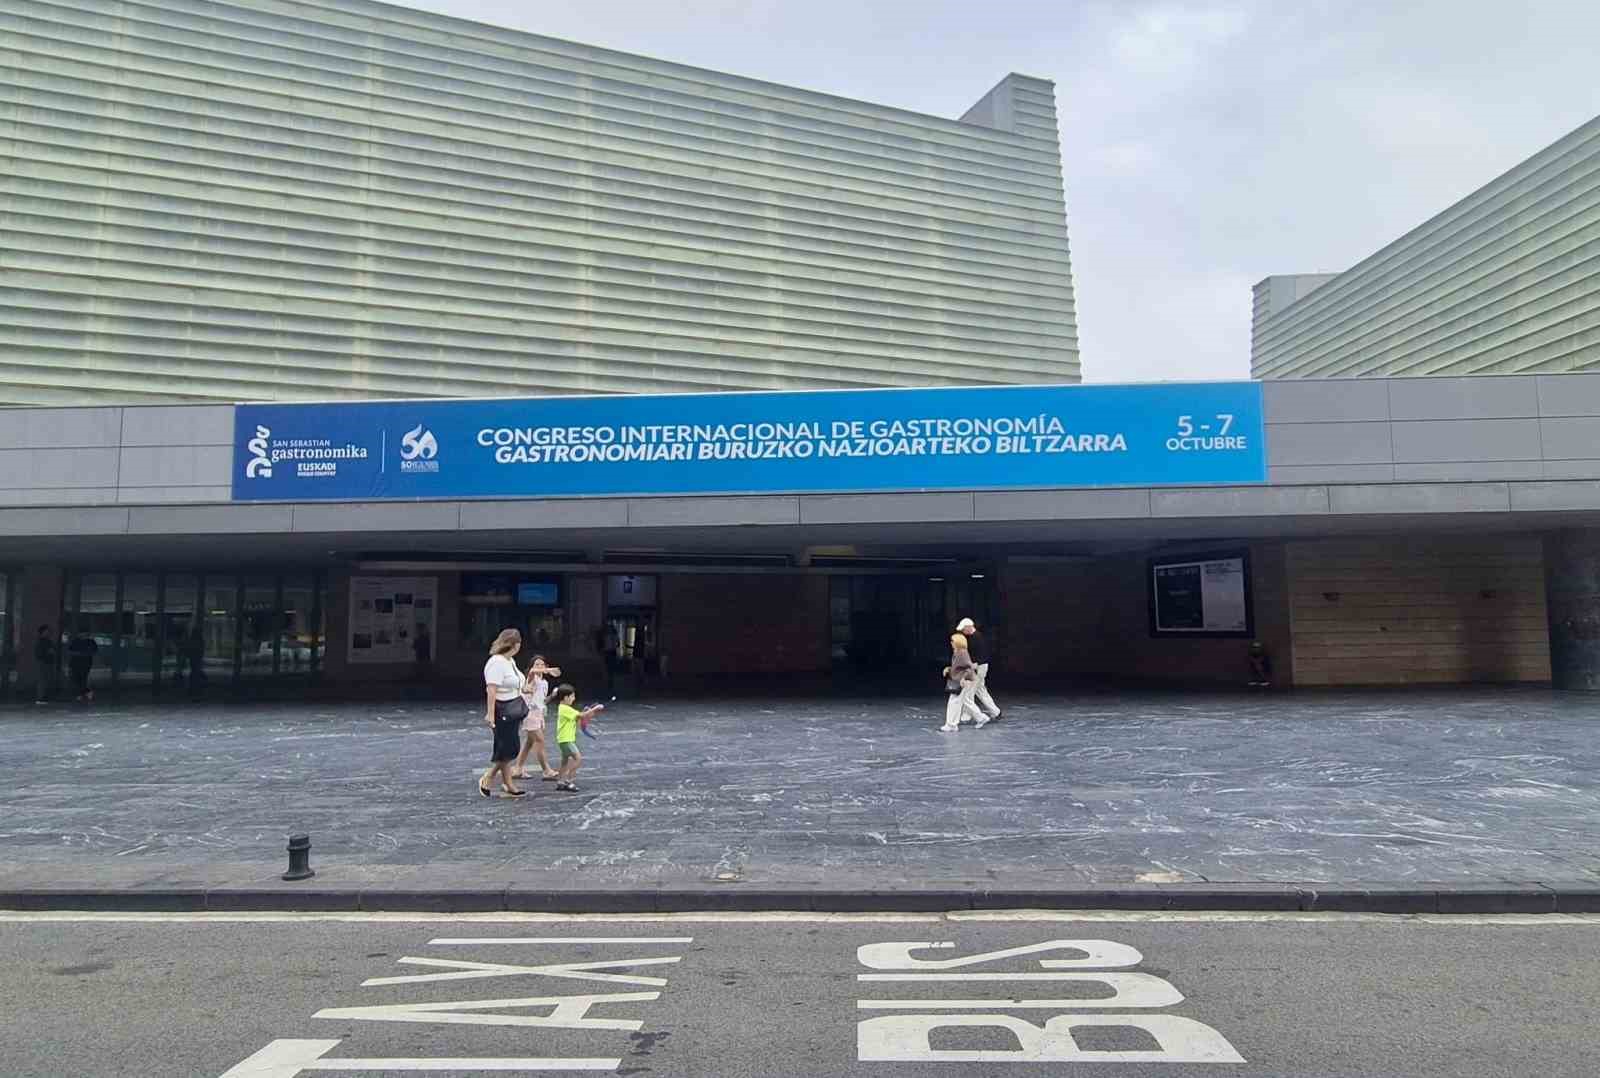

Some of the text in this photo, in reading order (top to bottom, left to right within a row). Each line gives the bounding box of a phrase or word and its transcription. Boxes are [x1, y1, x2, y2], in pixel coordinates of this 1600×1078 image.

[477, 414, 1065, 446] CONGRESO INTERNACIONAL DE GASTRONOMÍA
[1177, 416, 1193, 436] 5
[1217, 415, 1233, 435] 7
[271, 444, 368, 462] gastronomika
[272, 439, 330, 448] SAN SEBASTIAN
[495, 434, 1127, 464] GASTRONOMIARI BURUZKO NAZIOARTEKO BILTZARRA
[1166, 437, 1247, 451] OCTUBRE
[297, 462, 336, 471] EUSKADI
[217, 937, 693, 1078] TAXI
[856, 938, 1247, 1064] BUS
